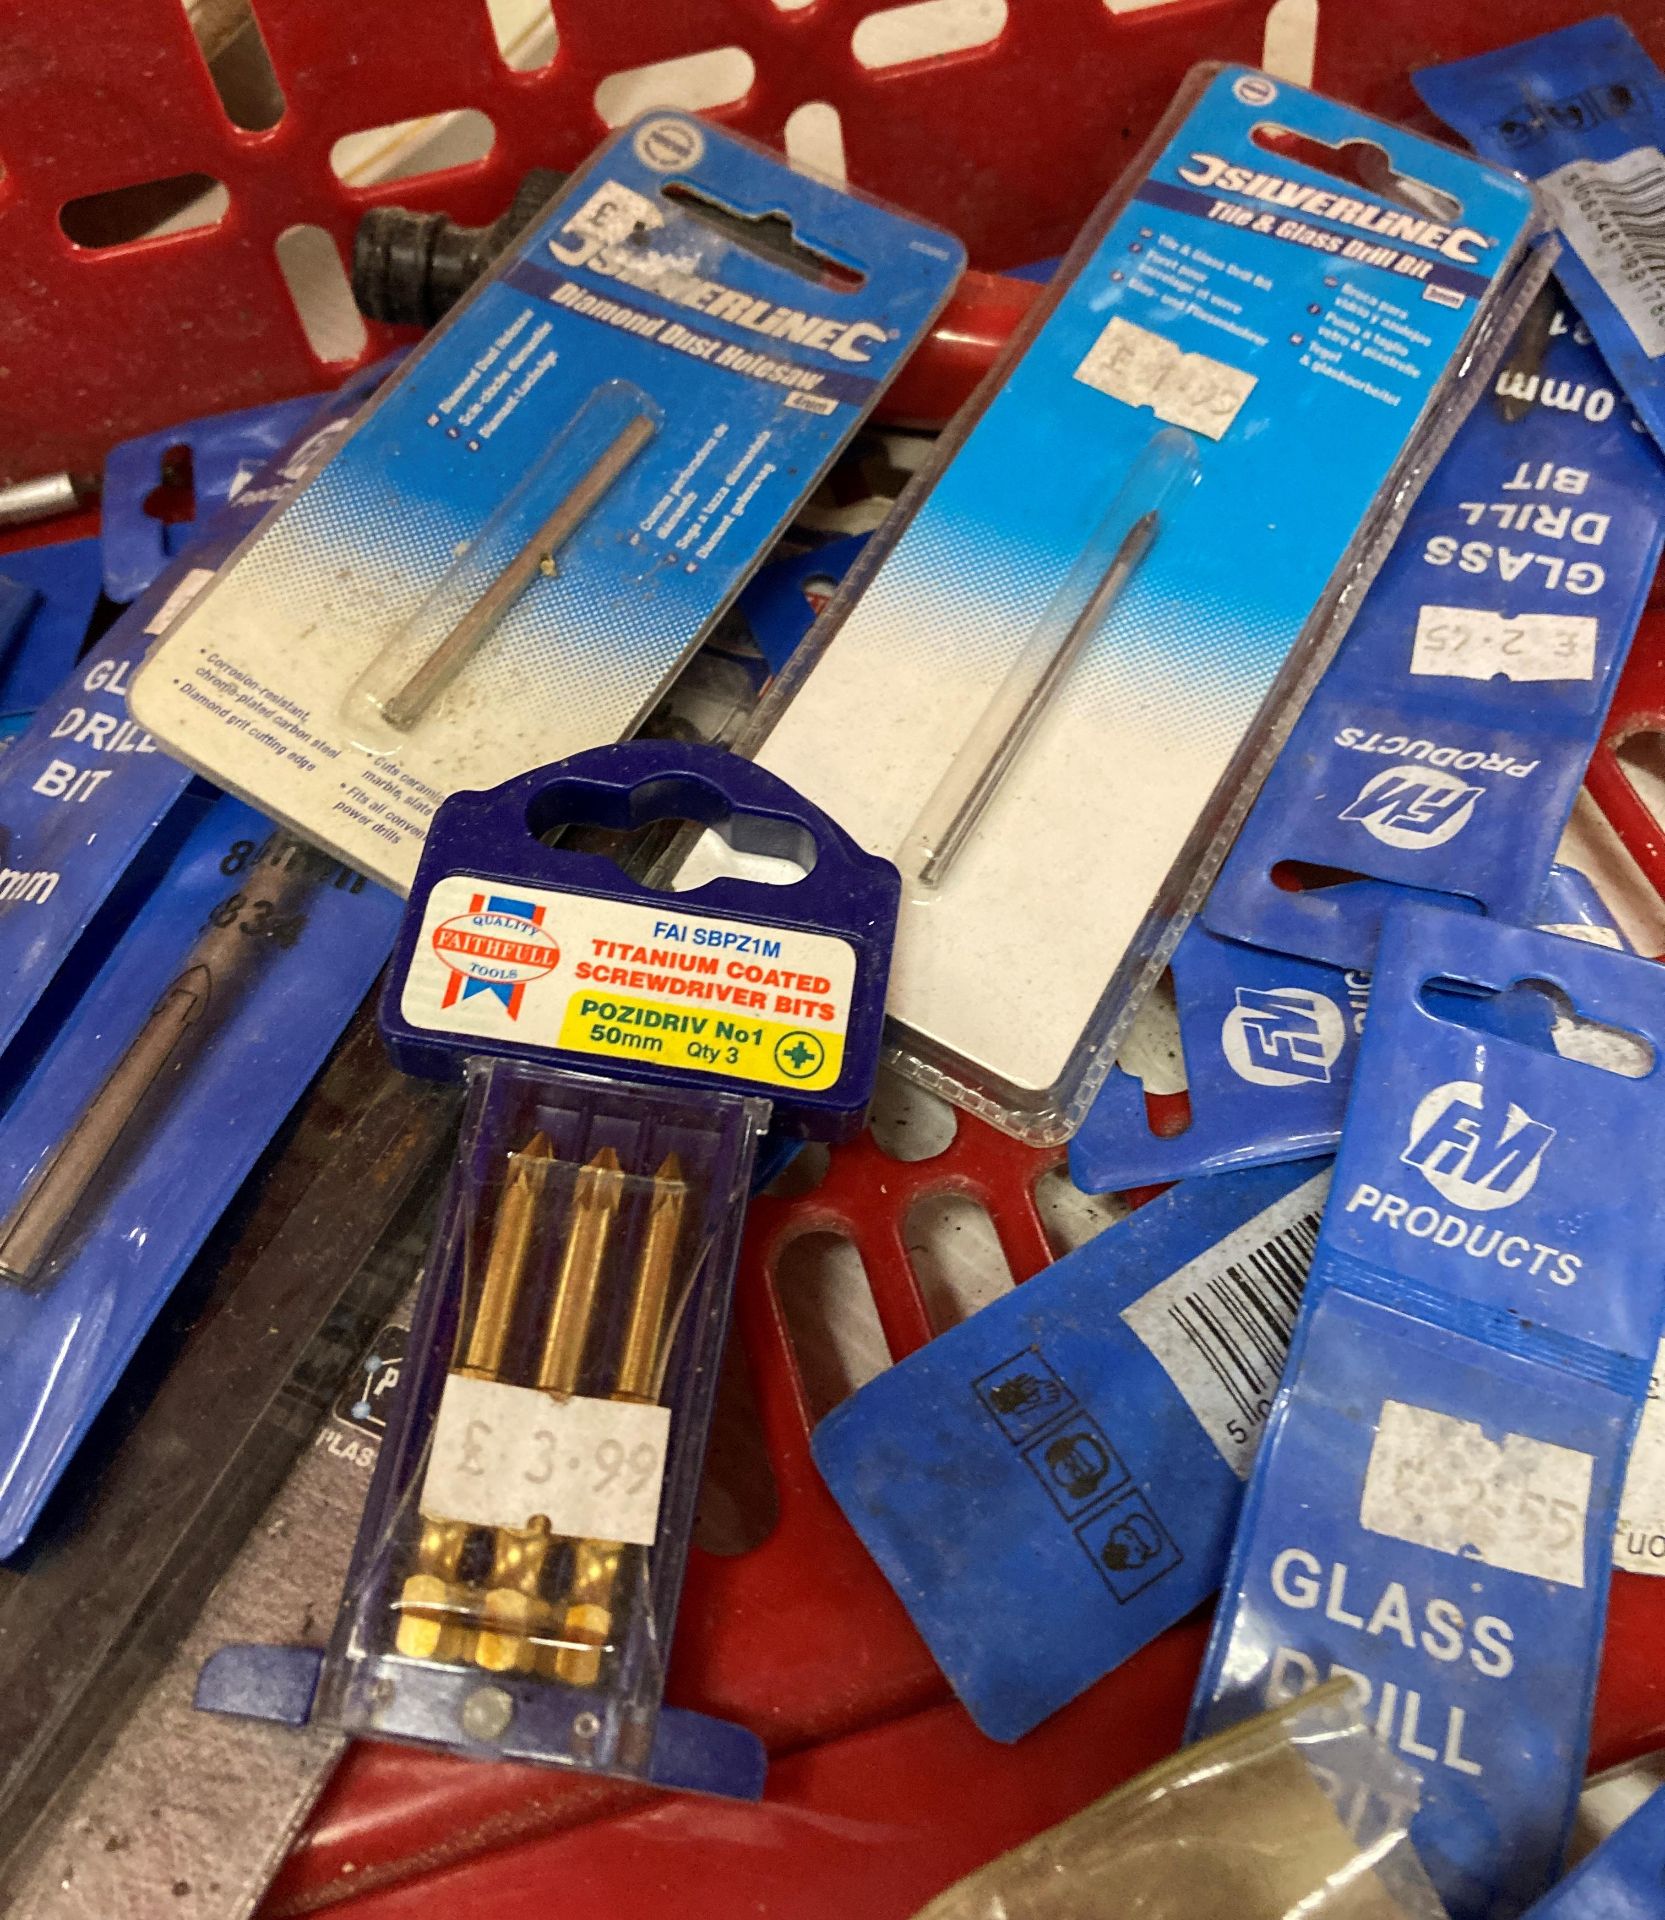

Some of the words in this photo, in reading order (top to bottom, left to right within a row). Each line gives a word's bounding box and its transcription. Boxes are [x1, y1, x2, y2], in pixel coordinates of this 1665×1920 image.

[1208, 200, 1249, 230] Tile
[1253, 211, 1274, 234] &
[1276, 220, 1342, 256] Glass
[1345, 238, 1400, 269] Drill
[1401, 254, 1433, 280] Bit
[550, 283, 658, 336] Diamond
[658, 328, 717, 362] Dust
[716, 343, 825, 389] Holesaw
[1503, 462, 1589, 495] BIT
[1458, 502, 1611, 545] DRILL
[1423, 535, 1604, 595] GLASS
[180, 683, 228, 719] Diamond
[227, 710, 249, 731] grit
[249, 725, 287, 755] cutting
[287, 752, 316, 773] edge
[195, 667, 273, 719] chrome-plated
[273, 713, 311, 742] carbon
[310, 738, 342, 760] steel
[374, 756, 399, 777] Cuts
[1335, 727, 1540, 778] PRODUCTS
[32, 759, 112, 802] BIT
[334, 800, 370, 827] power
[371, 821, 402, 845] drills
[349, 787, 368, 805] Fits
[368, 799, 385, 815] all
[385, 812, 426, 841] conven
[437, 930, 553, 966] FAITHFULL
[473, 916, 538, 936] QUALITY
[654, 922, 688, 941] FAI
[693, 928, 781, 958] SBPZ1M
[470, 962, 518, 979] TOOLS
[592, 939, 719, 975] TITANIUM
[727, 961, 832, 994] COATED
[575, 962, 767, 1010] SCREWDRIVER
[775, 996, 835, 1021] BITS
[580, 1000, 708, 1034] POZIDRIV
[715, 1021, 763, 1045] No1
[590, 1024, 663, 1052] 50mm
[687, 1041, 721, 1064] Qty
[725, 1046, 738, 1064] 3
[1346, 1184, 1584, 1287] PRODUCTS
[315, 1426, 376, 1467] PLAS
[458, 1420, 492, 1476] £
[525, 1429, 658, 1497] 3.99
[1271, 1549, 1515, 1678] GLASS
